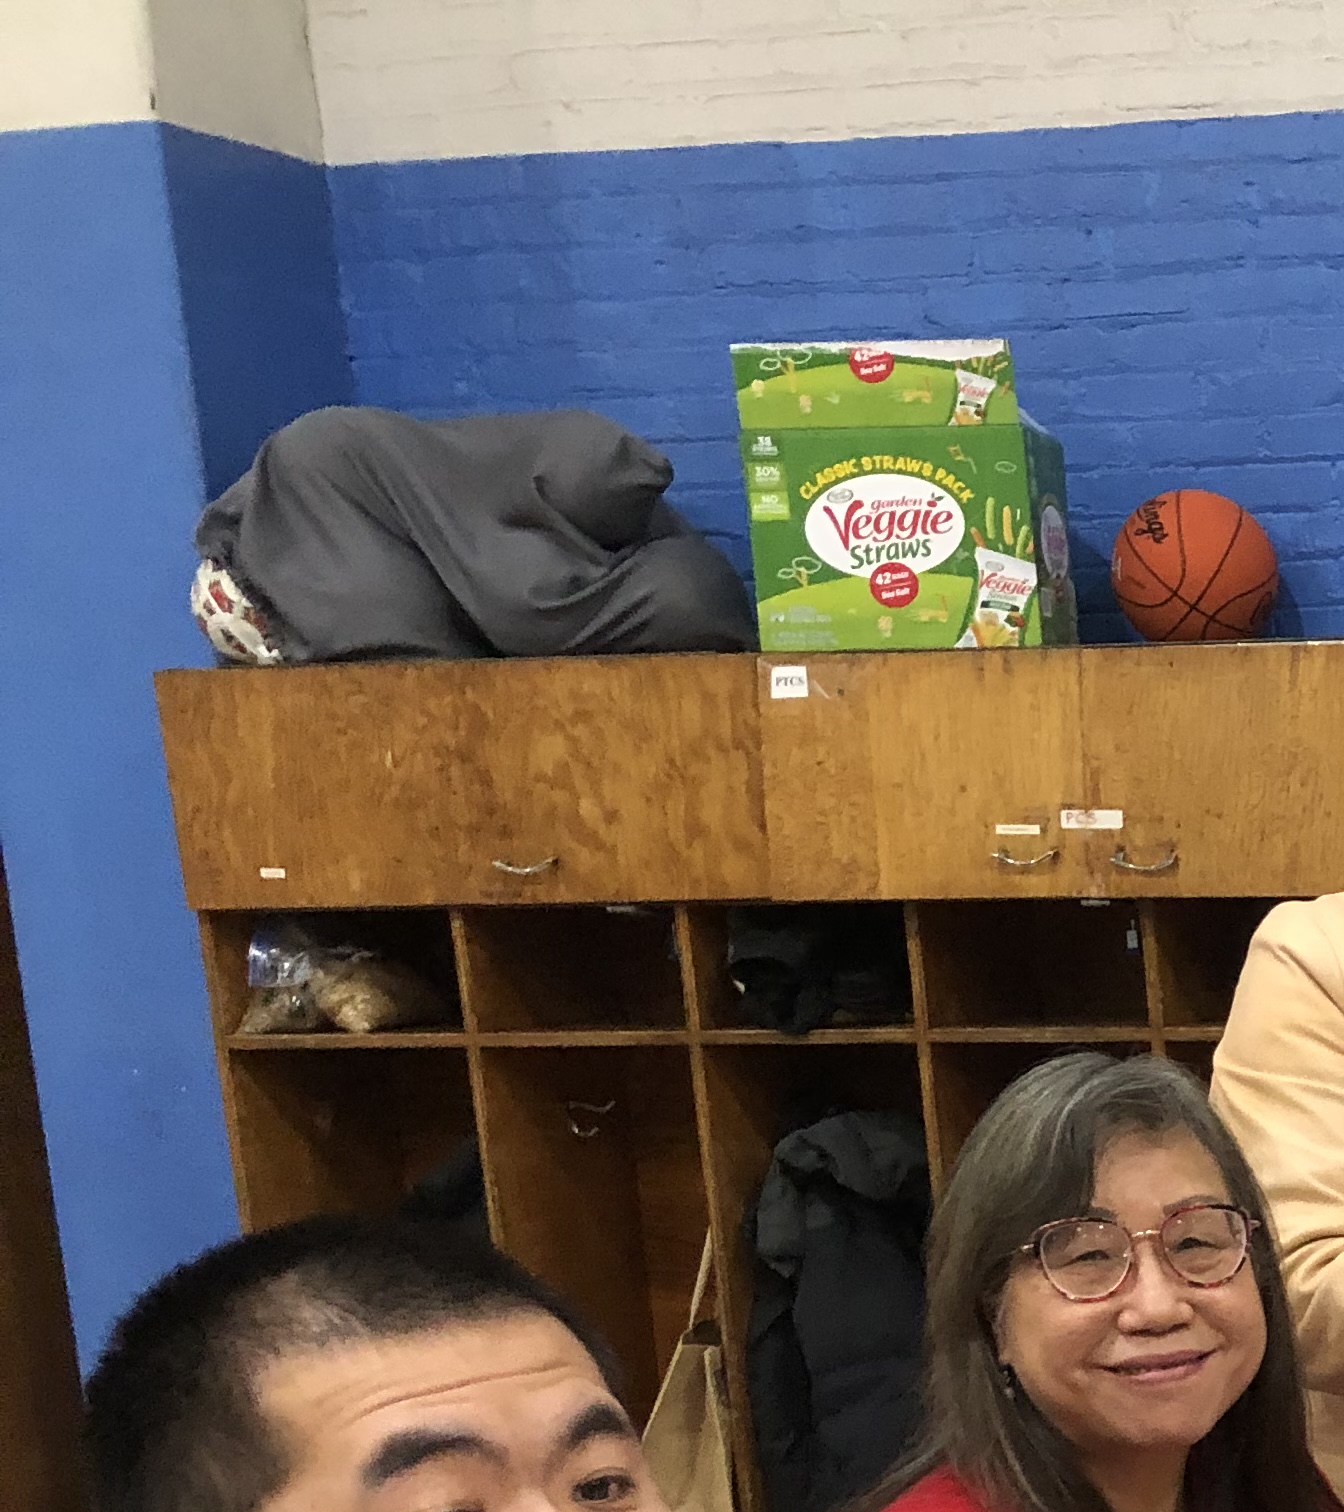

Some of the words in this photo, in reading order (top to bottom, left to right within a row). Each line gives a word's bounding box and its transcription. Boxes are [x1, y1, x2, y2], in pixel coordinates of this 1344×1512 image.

[800, 458, 858, 499] CLASSIC
[861, 455, 934, 476] STRAWS
[934, 467, 975, 503] PACK
[871, 495, 923, 513] garden
[823, 500, 954, 551] Veggie
[850, 538, 932, 570] Straws
[875, 571, 892, 585] 42
